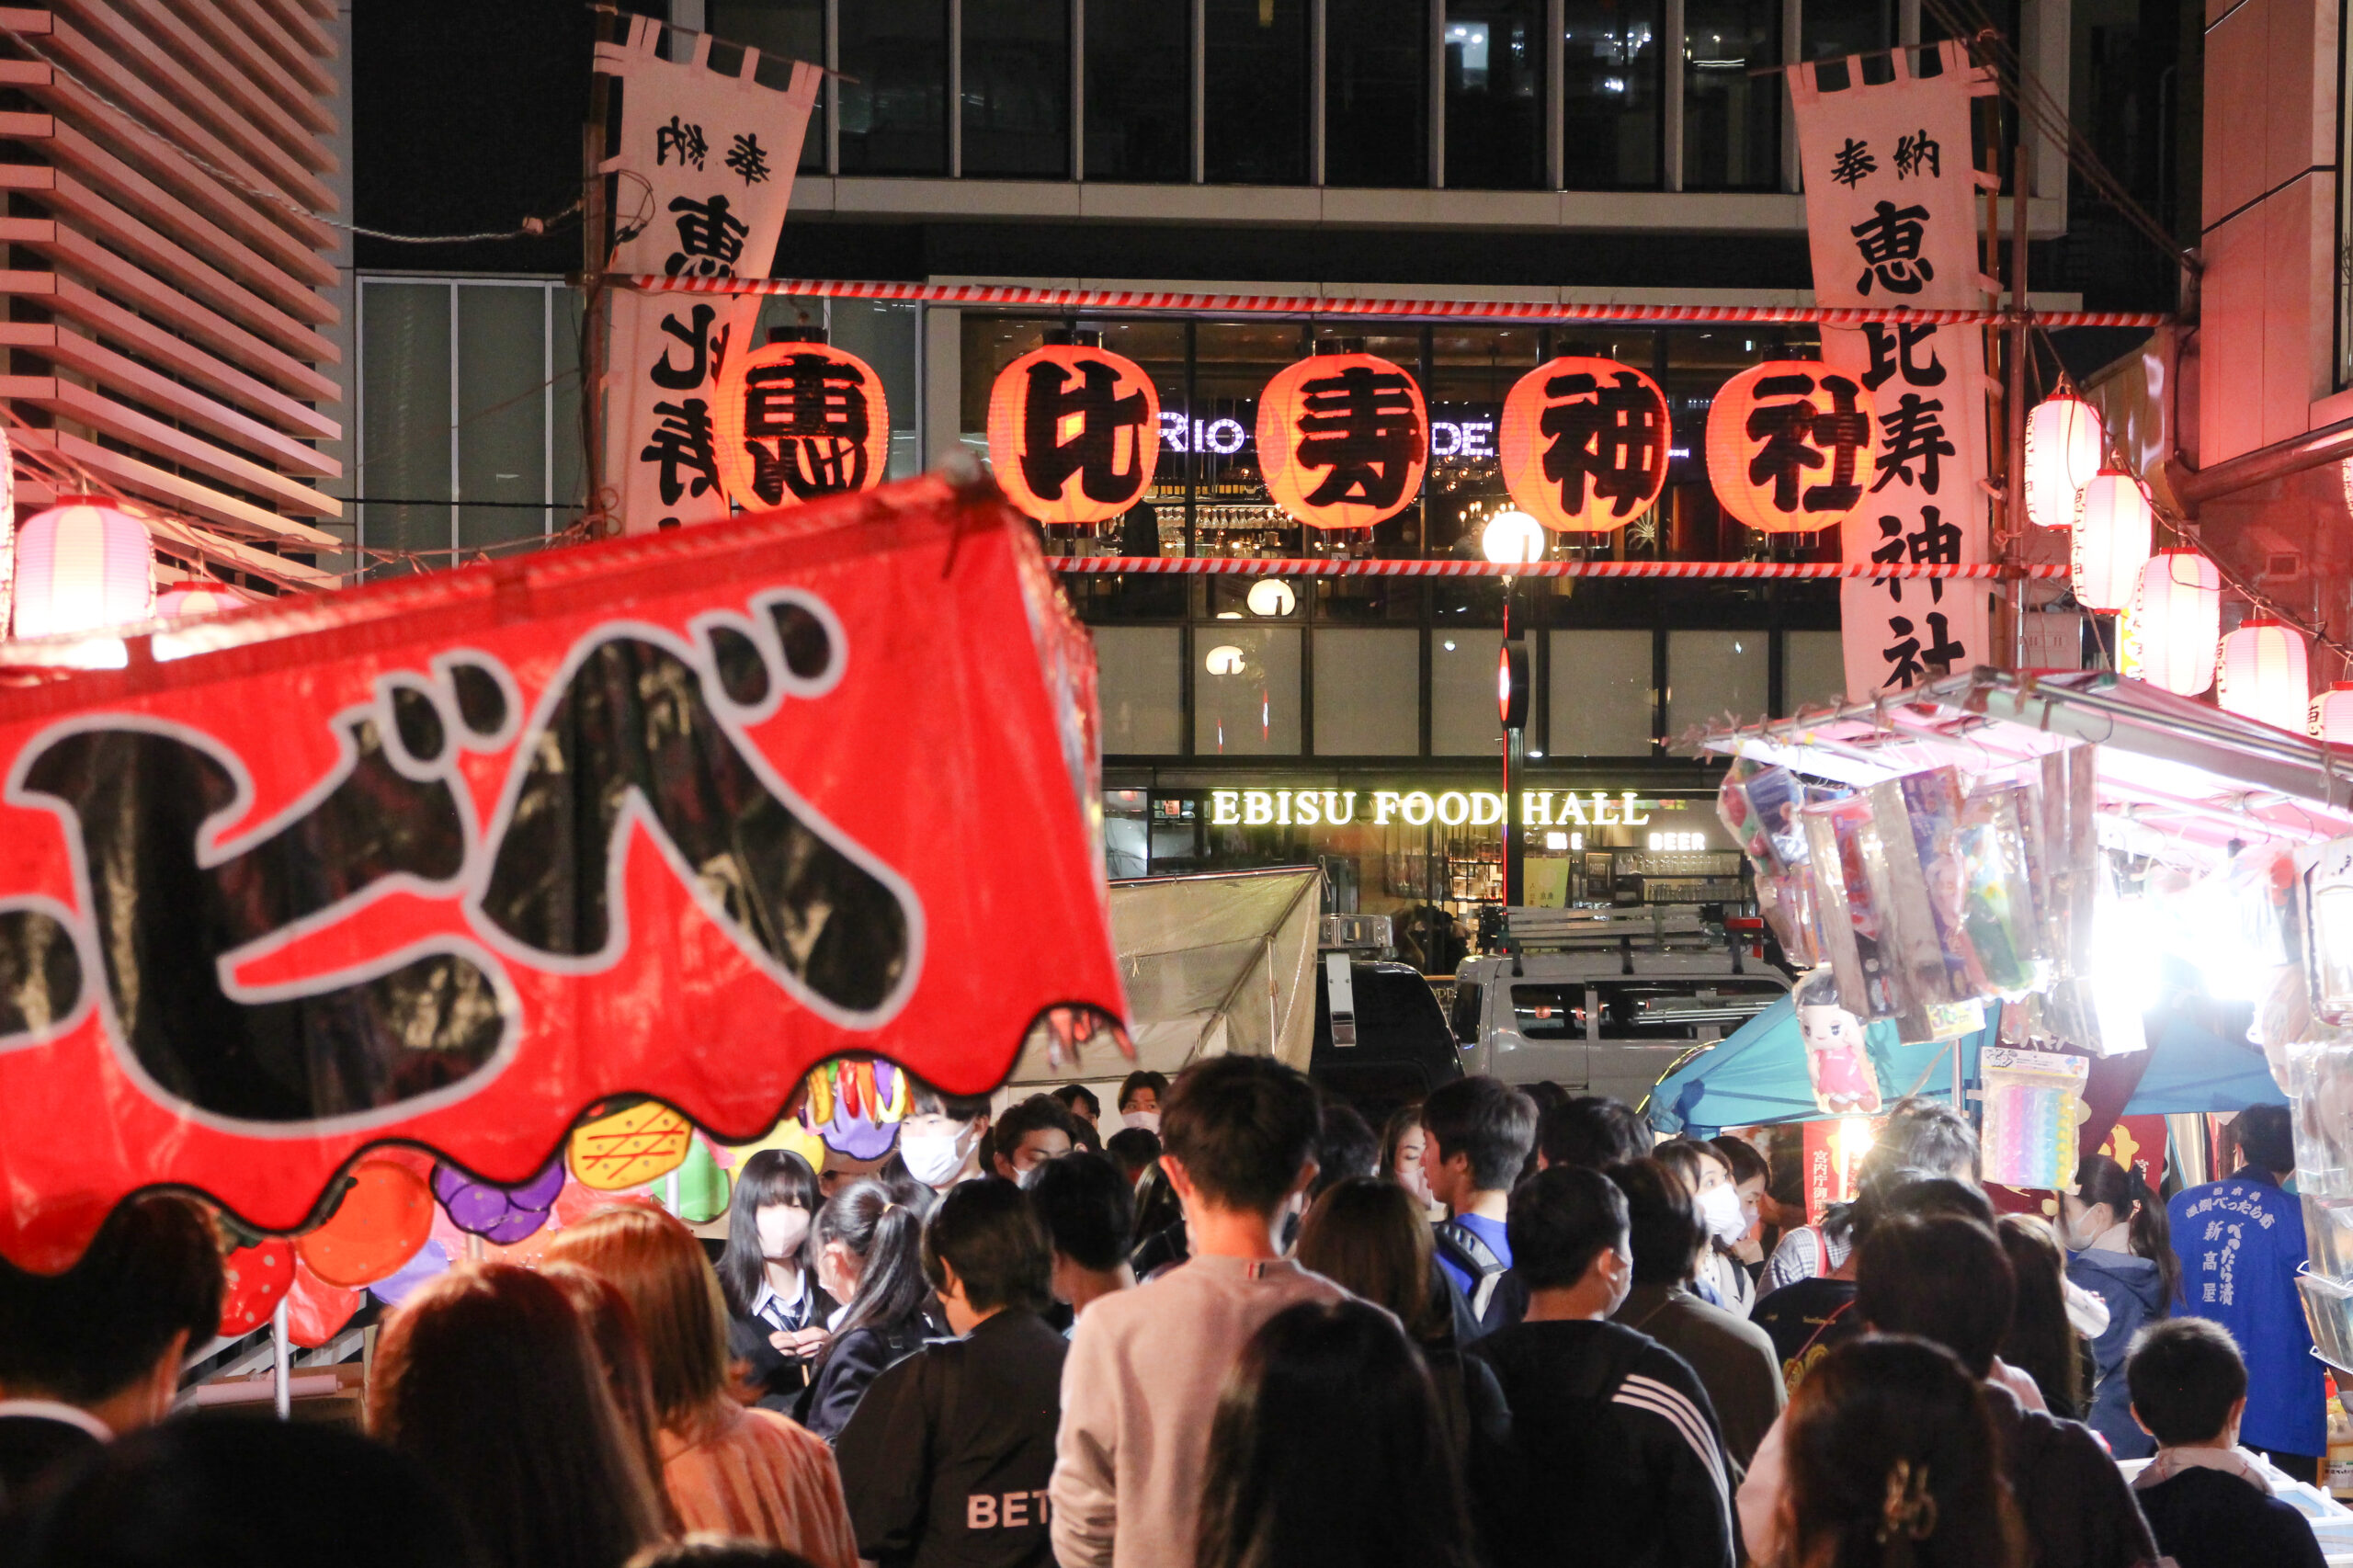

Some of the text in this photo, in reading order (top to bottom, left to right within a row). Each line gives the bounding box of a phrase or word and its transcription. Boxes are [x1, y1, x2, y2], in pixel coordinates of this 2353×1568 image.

[1831, 129, 1940, 190] 奉納
[1851, 200, 1966, 691] 恵比寿神社
[1211, 791, 1650, 826] EBISU FOOD HALL
[1649, 833, 1706, 850] BEER
[2219, 1222, 2245, 1306] べったら漬
